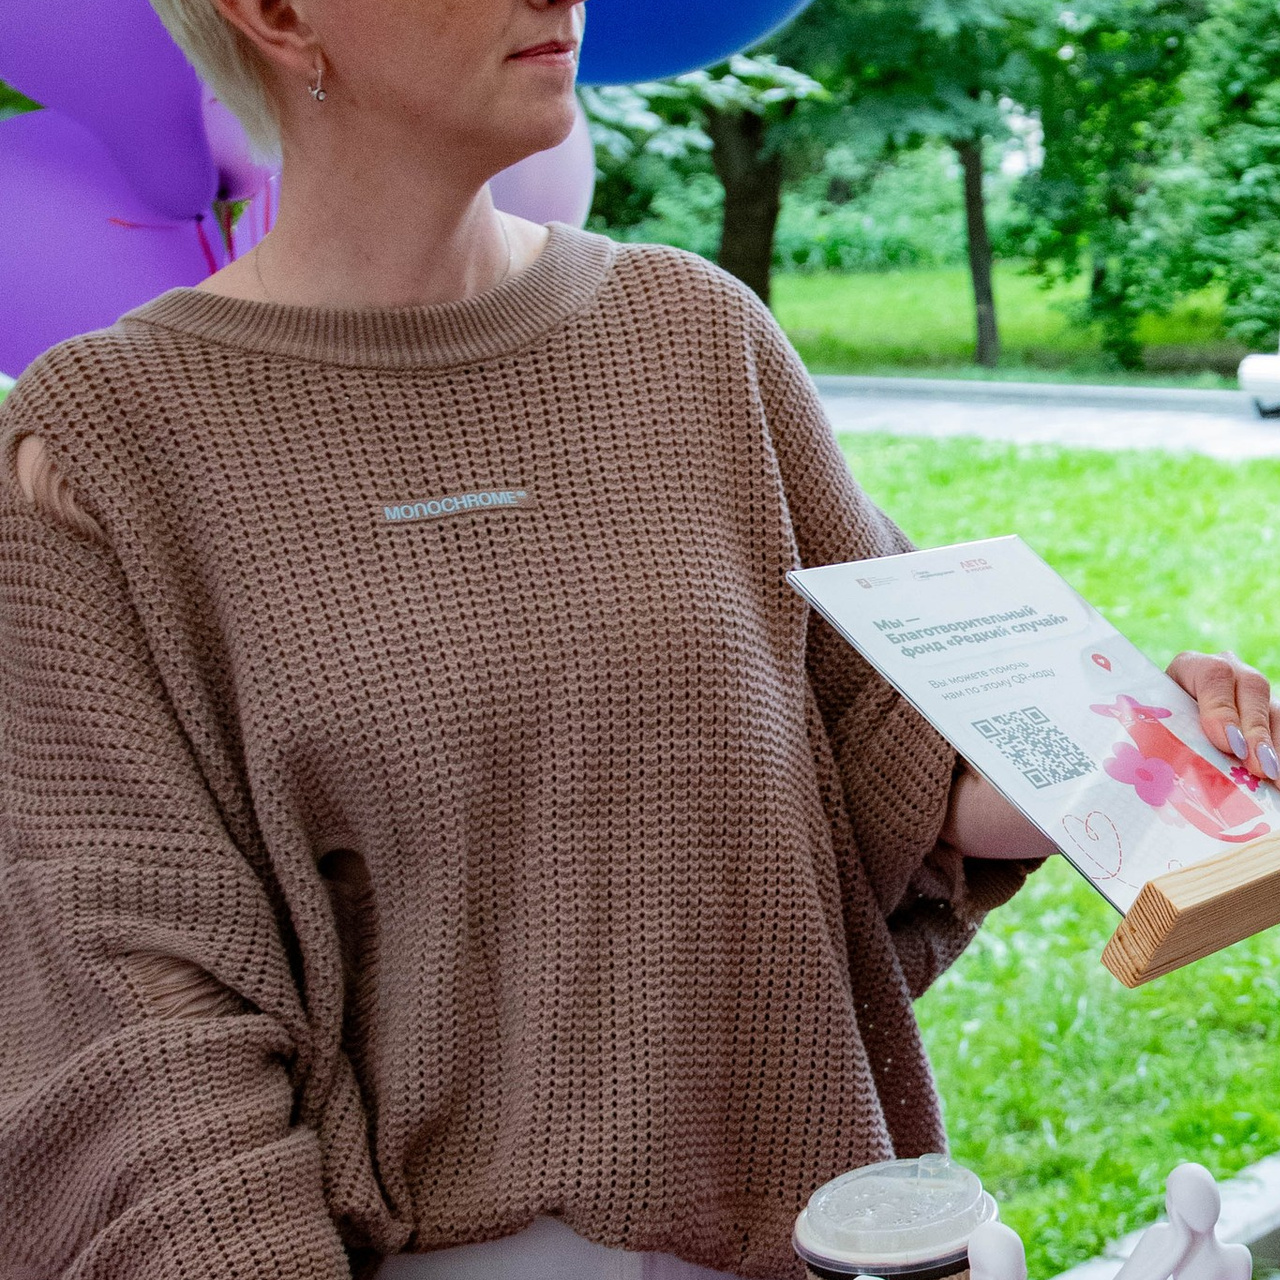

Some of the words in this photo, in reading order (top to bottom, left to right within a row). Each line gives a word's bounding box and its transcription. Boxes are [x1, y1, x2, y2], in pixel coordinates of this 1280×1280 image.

[960, 558, 988, 569] ЛЕТО
[873, 618, 903, 632] Мы
[885, 605, 1038, 644] Благотворительный
[901, 639, 946, 659] фонд
[946, 626, 1010, 648] «Редкий
[1011, 614, 1069, 634] случай»
[928, 678, 948, 689] Вы
[948, 670, 989, 685] можете
[989, 660, 1030, 675] помочь
[942, 688, 965, 701] нам
[965, 686, 981, 696] по
[980, 676, 1013, 693] этому
[1011, 667, 1056, 685] QR-коду
